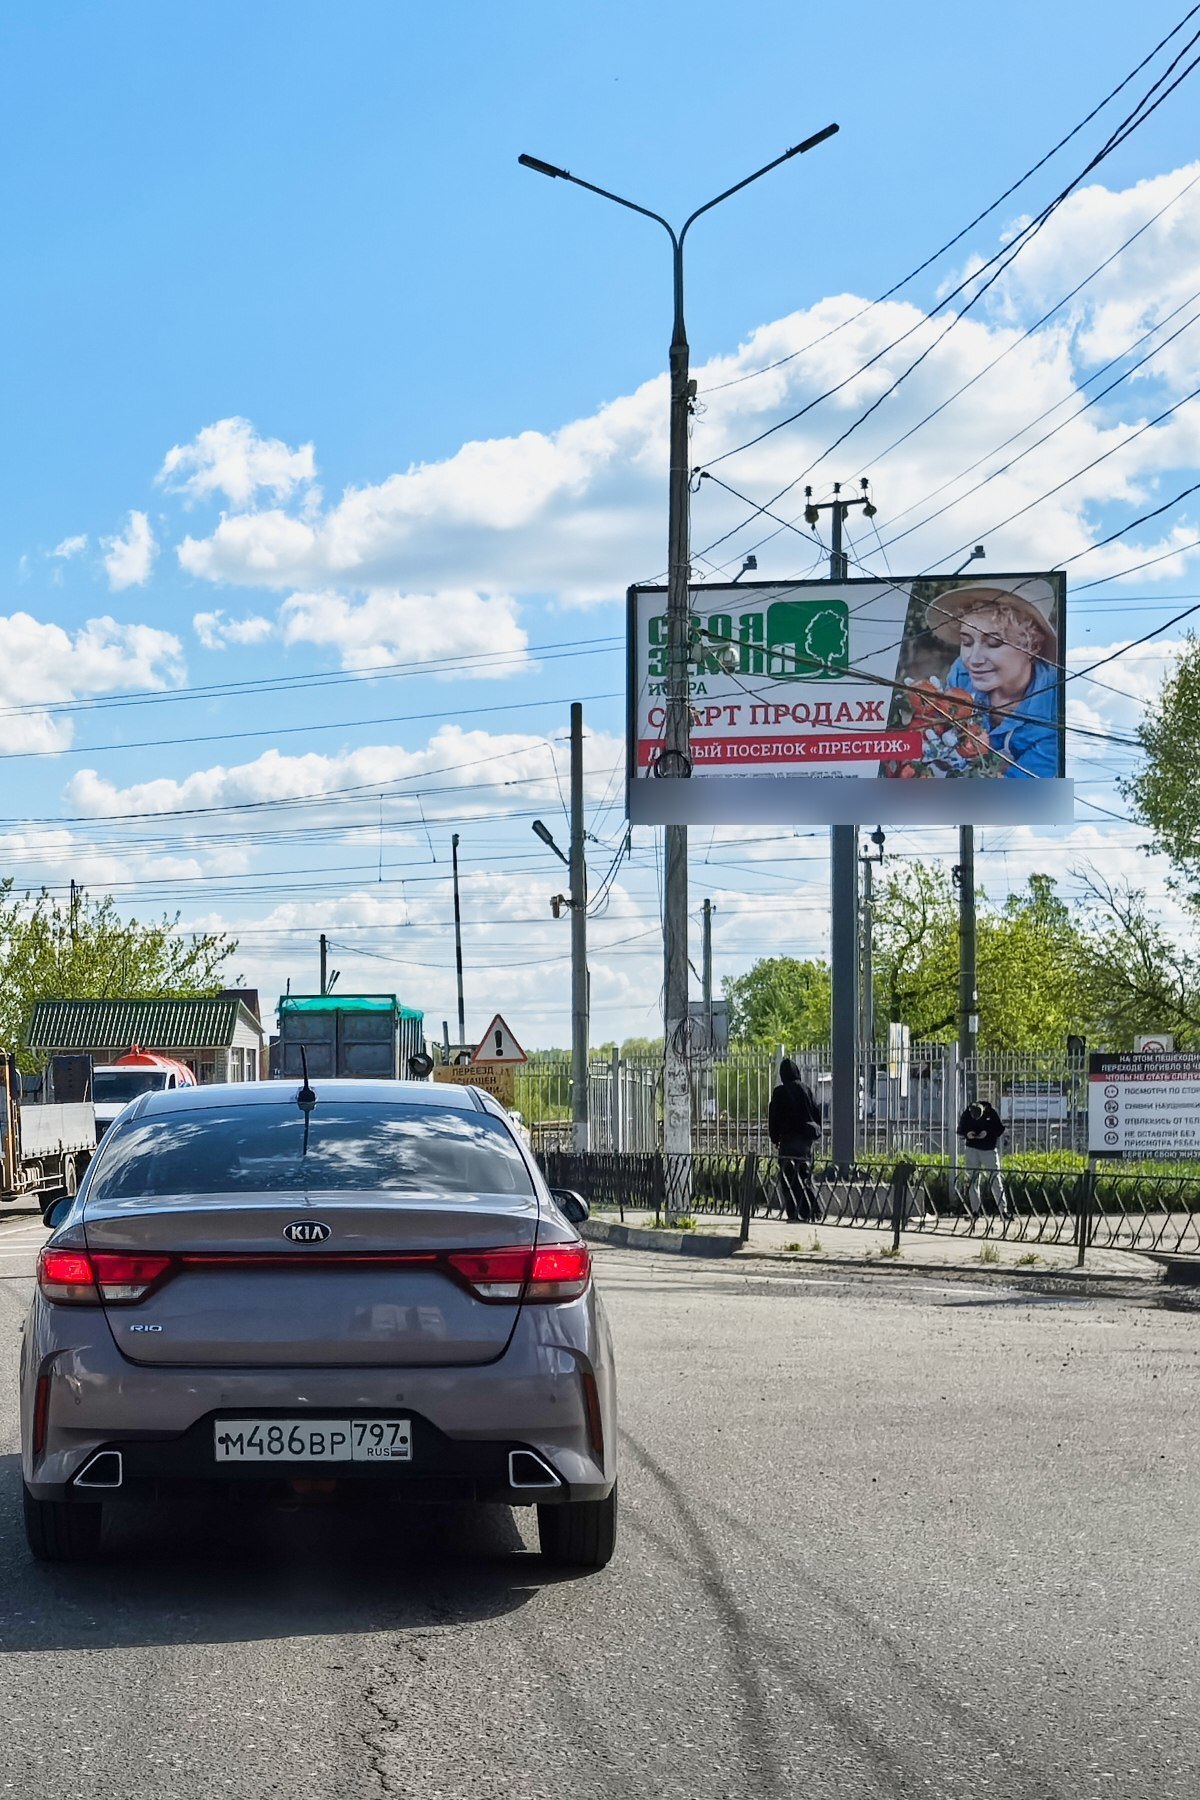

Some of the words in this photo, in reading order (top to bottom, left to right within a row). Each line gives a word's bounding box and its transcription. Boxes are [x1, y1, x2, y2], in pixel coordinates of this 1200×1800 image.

[647, 704, 741, 728] САРТ
[750, 700, 885, 728] ПРОДАЖ
[726, 743, 806, 758] ПОСЕЛОК
[810, 739, 910, 756] «ПРЕСТИЖ»
[452, 1066, 494, 1076] ПЕРЕЕЗД
[291, 1225, 324, 1240] KIA
[130, 1324, 162, 1332] RIO
[353, 1423, 400, 1447] 797
[367, 1447, 390, 1457] RUS
